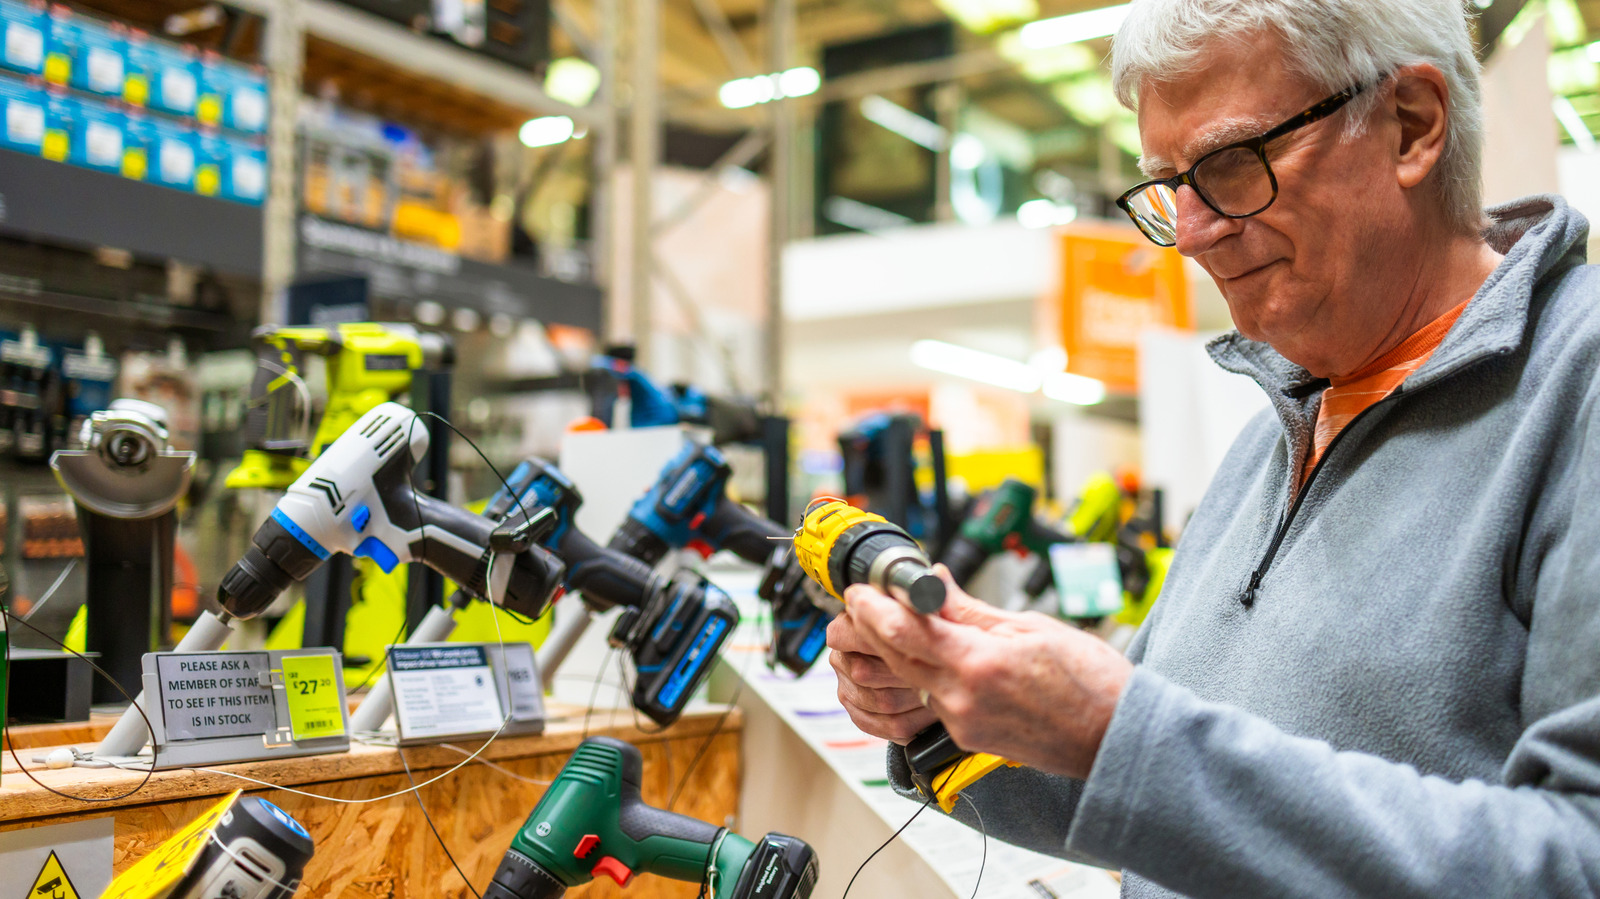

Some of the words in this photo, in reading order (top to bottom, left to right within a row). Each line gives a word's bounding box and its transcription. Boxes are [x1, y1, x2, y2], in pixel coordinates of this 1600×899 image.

[180, 661, 218, 672] PLEASE
[220, 660, 240, 671] ASK
[243, 660, 250, 670] A
[168, 679, 217, 691] MEMBER
[219, 678, 233, 688] OF
[236, 677, 260, 688] STAF
[168, 699, 184, 709] TO
[186, 698, 205, 709] SEE
[207, 697, 216, 707] IF
[218, 696, 242, 707] THIS
[244, 694, 269, 705] ITEM
[192, 716, 202, 727] IS
[204, 715, 215, 726] IN
[218, 713, 252, 725] STOCK
[766, 866, 779, 885] Battery
